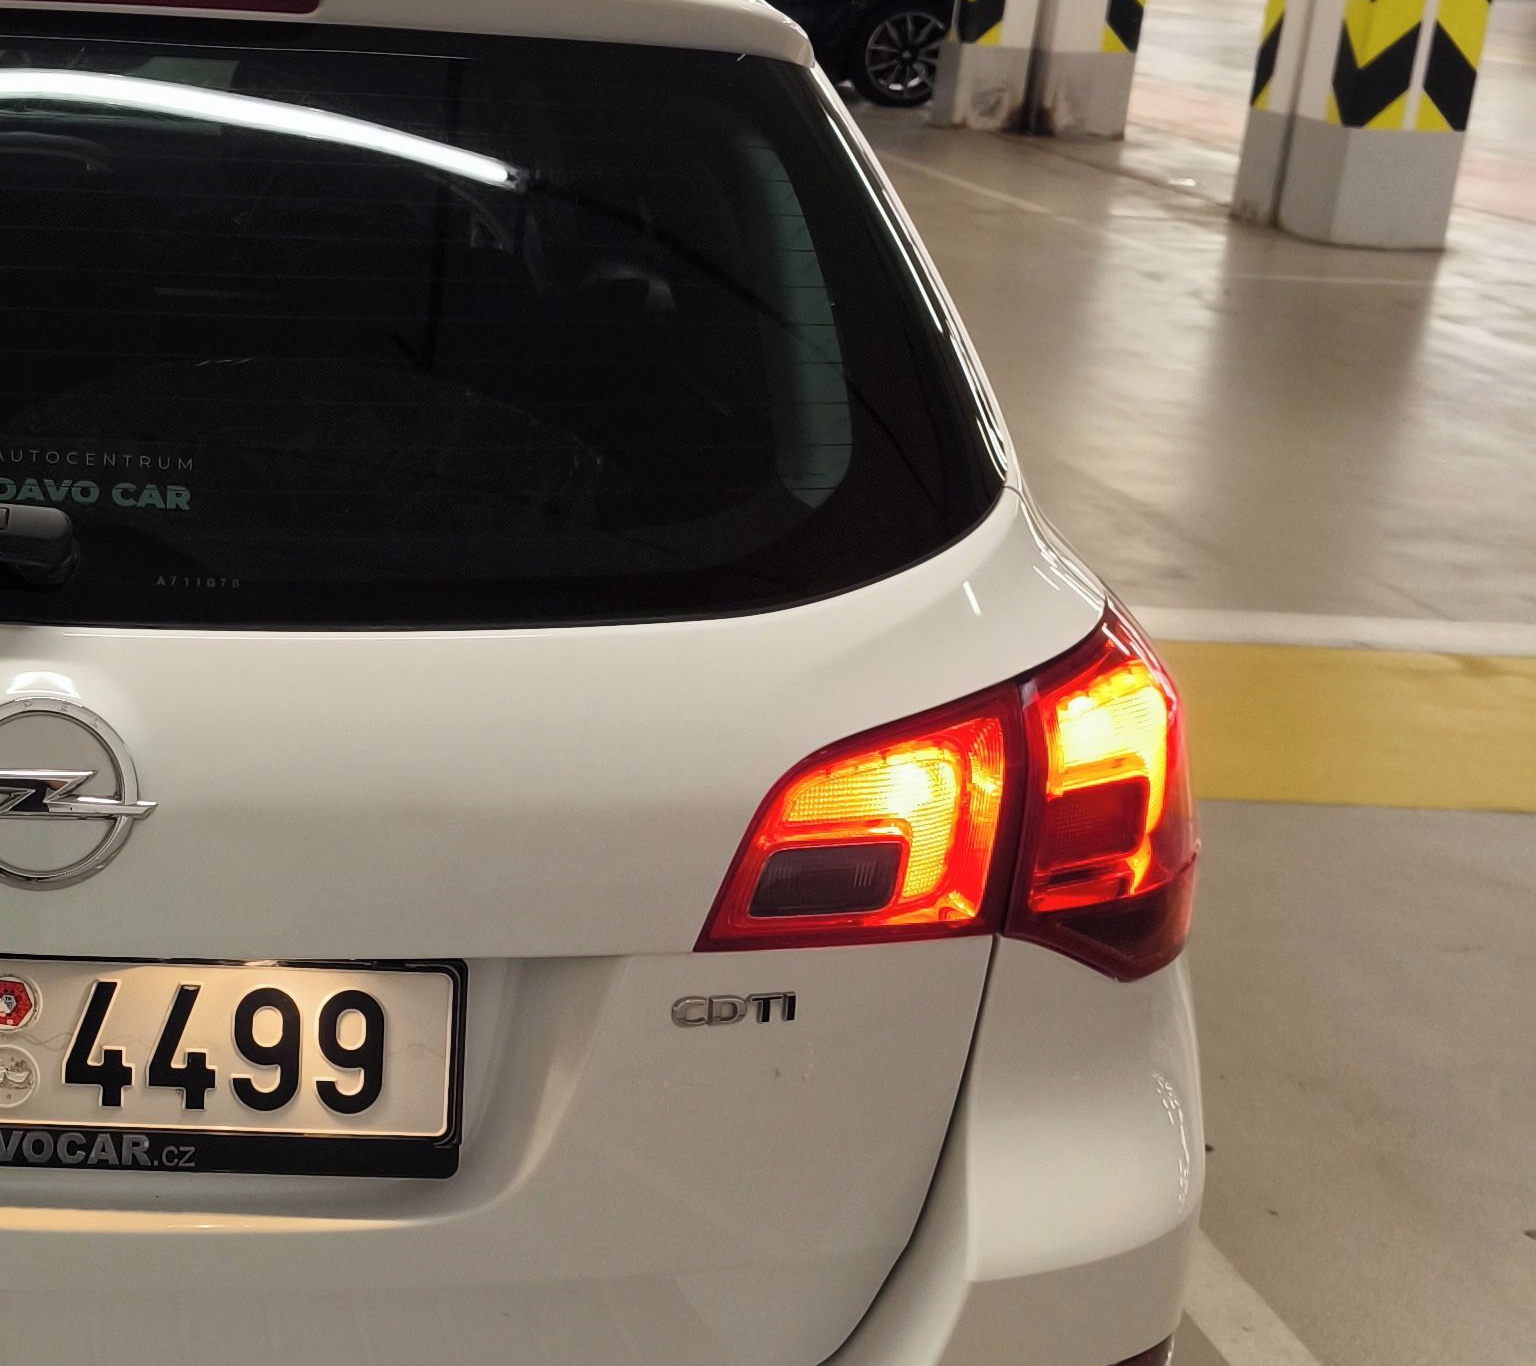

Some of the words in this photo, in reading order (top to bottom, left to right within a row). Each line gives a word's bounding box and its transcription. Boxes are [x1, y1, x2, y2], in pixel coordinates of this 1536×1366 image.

[112, 483, 192, 511] CAR
[671, 991, 796, 1028] CDTI
[64, 981, 385, 1115] 4499
